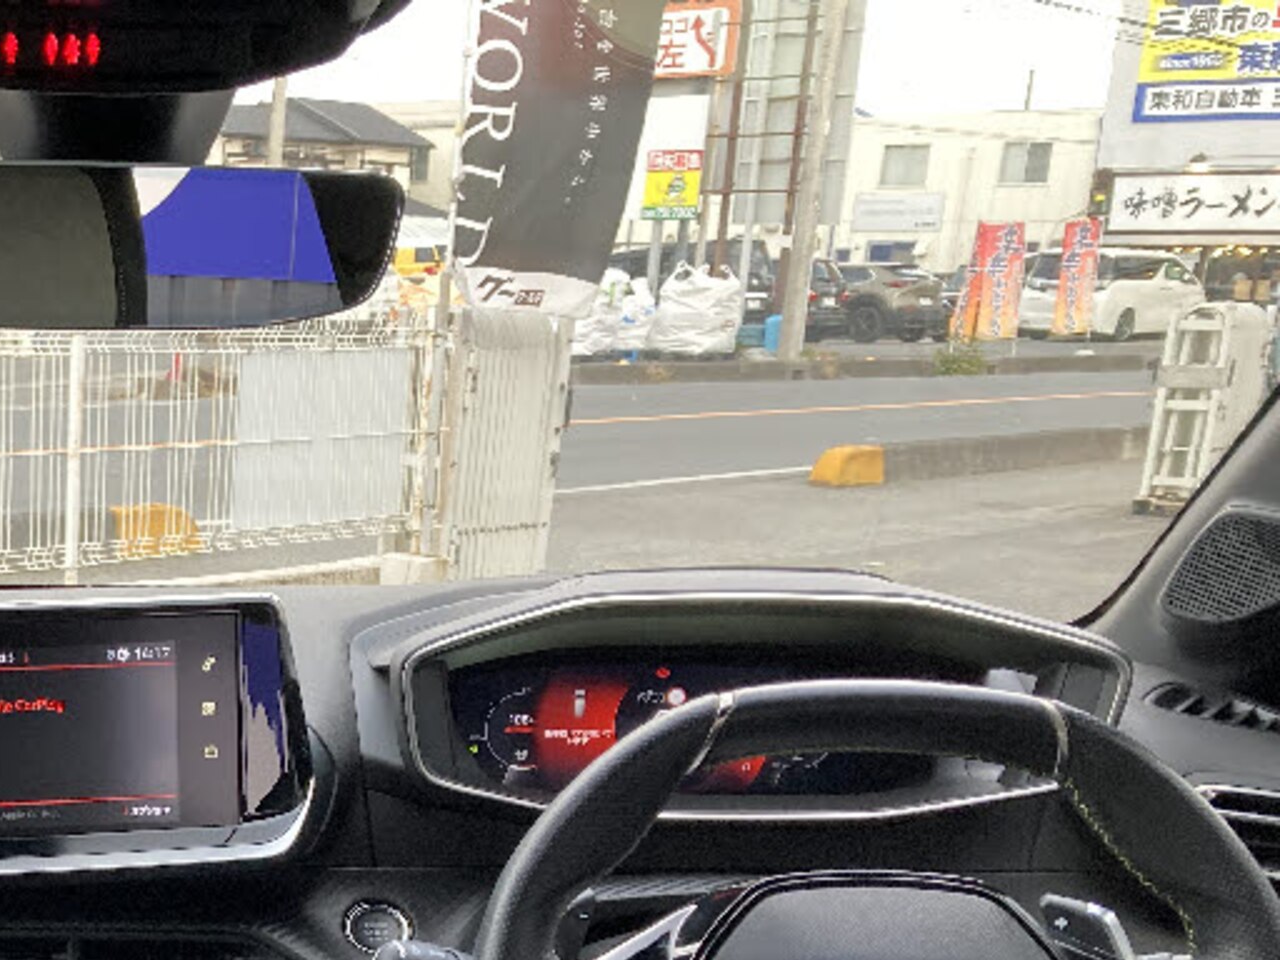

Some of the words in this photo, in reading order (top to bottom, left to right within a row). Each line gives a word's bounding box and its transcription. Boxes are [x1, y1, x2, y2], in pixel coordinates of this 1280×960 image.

[655, 39, 687, 68] 左
[1149, 87, 1263, 111] 東和自動車
[1124, 185, 1277, 219] 味噌ラーメン
